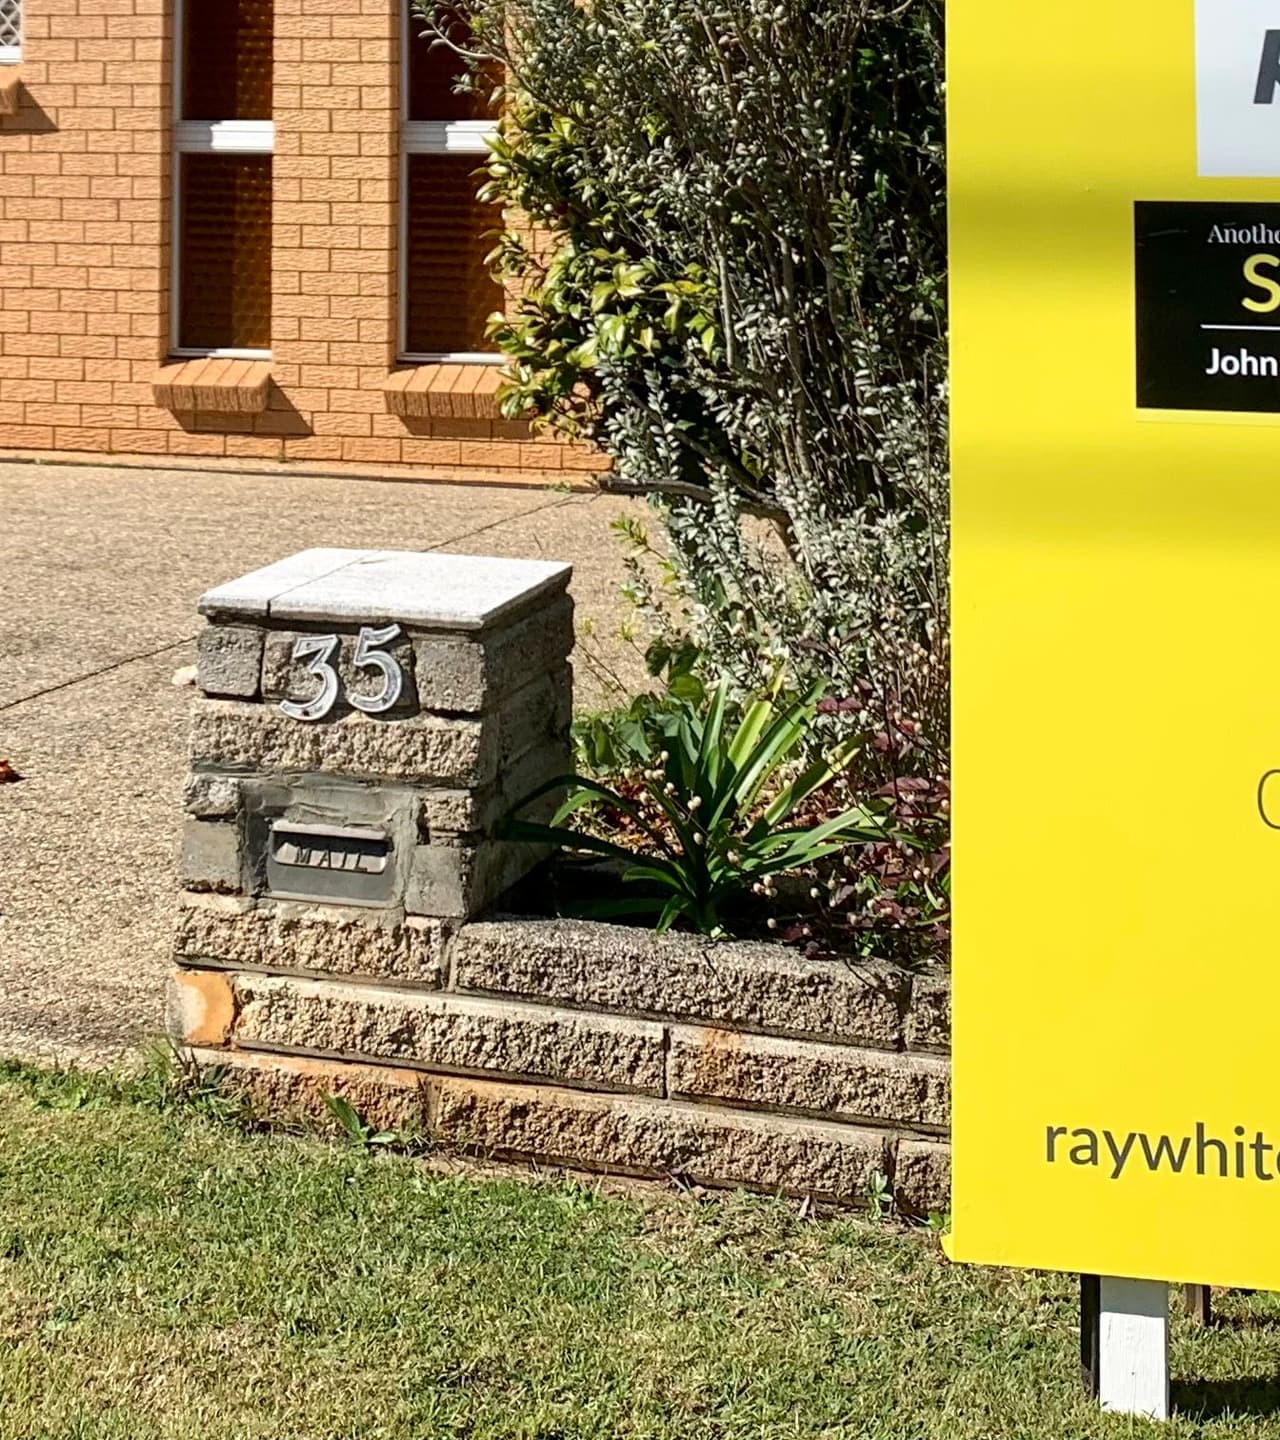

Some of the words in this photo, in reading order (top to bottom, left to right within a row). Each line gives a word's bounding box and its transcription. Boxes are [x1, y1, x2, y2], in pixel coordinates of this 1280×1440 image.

[1205, 347, 1278, 378] John
[278, 623, 403, 721] 35
[293, 843, 368, 873] MAIL
